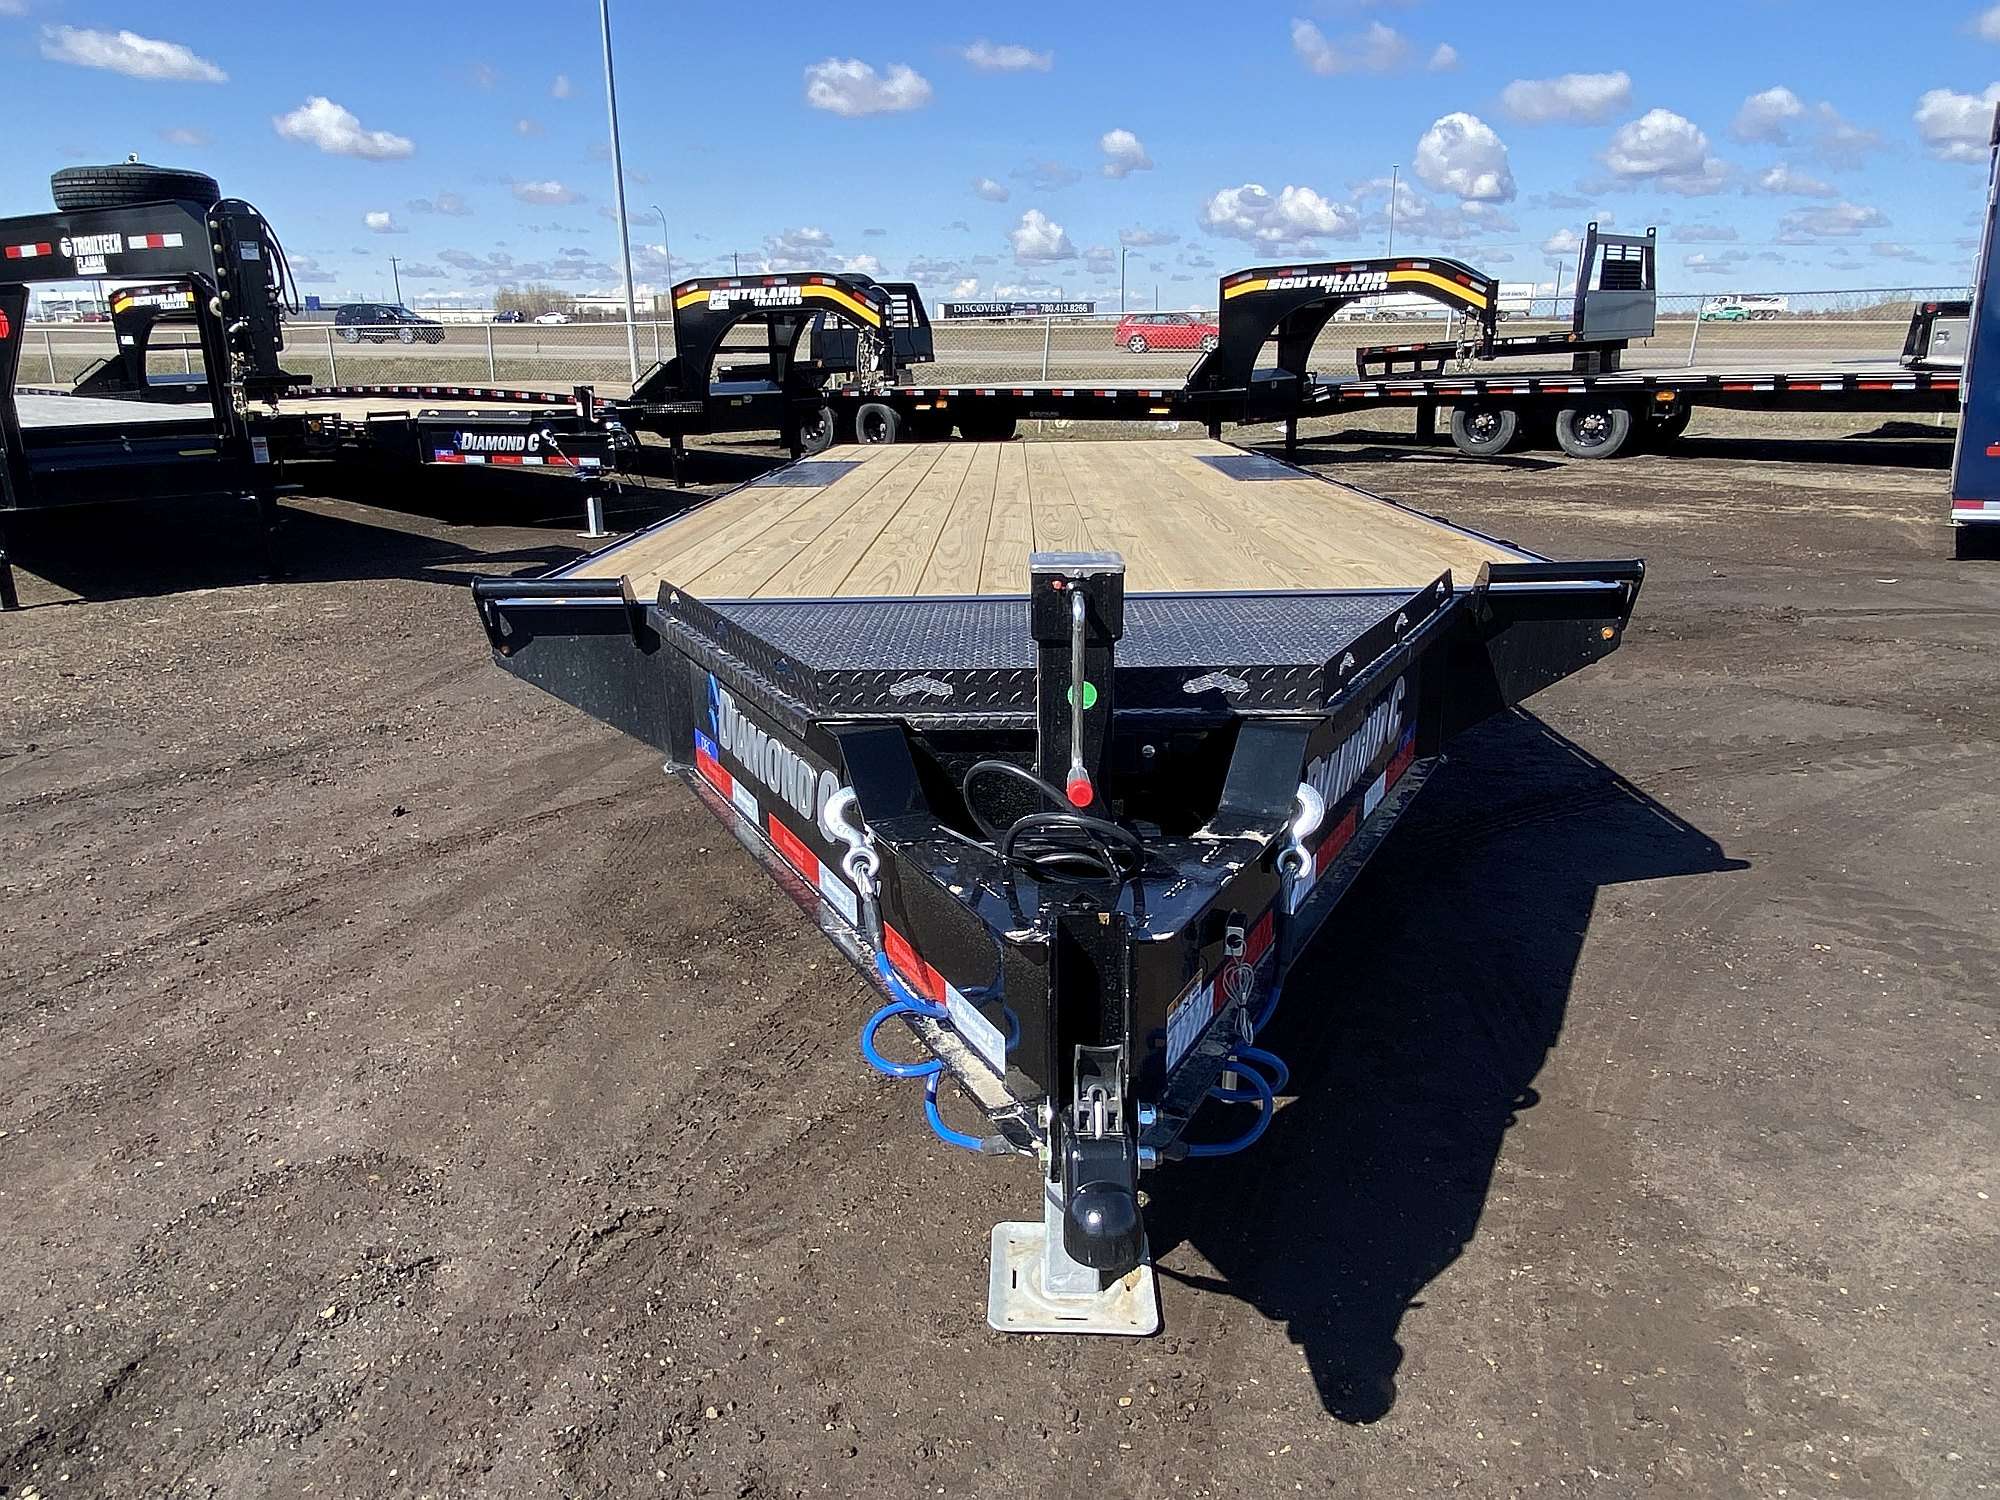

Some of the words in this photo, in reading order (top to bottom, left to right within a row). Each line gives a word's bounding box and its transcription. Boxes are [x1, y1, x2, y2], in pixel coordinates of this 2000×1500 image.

[71, 233, 123, 256] TRAILTECH
[1265, 271, 1388, 291] SOUTHLAND
[1323, 282, 1389, 294] TRAILERS
[953, 302, 1008, 314] DISCOVERY
[461, 432, 526, 451] DIAMOND
[527, 434, 540, 452] C
[718, 687, 818, 821] DIAMOND
